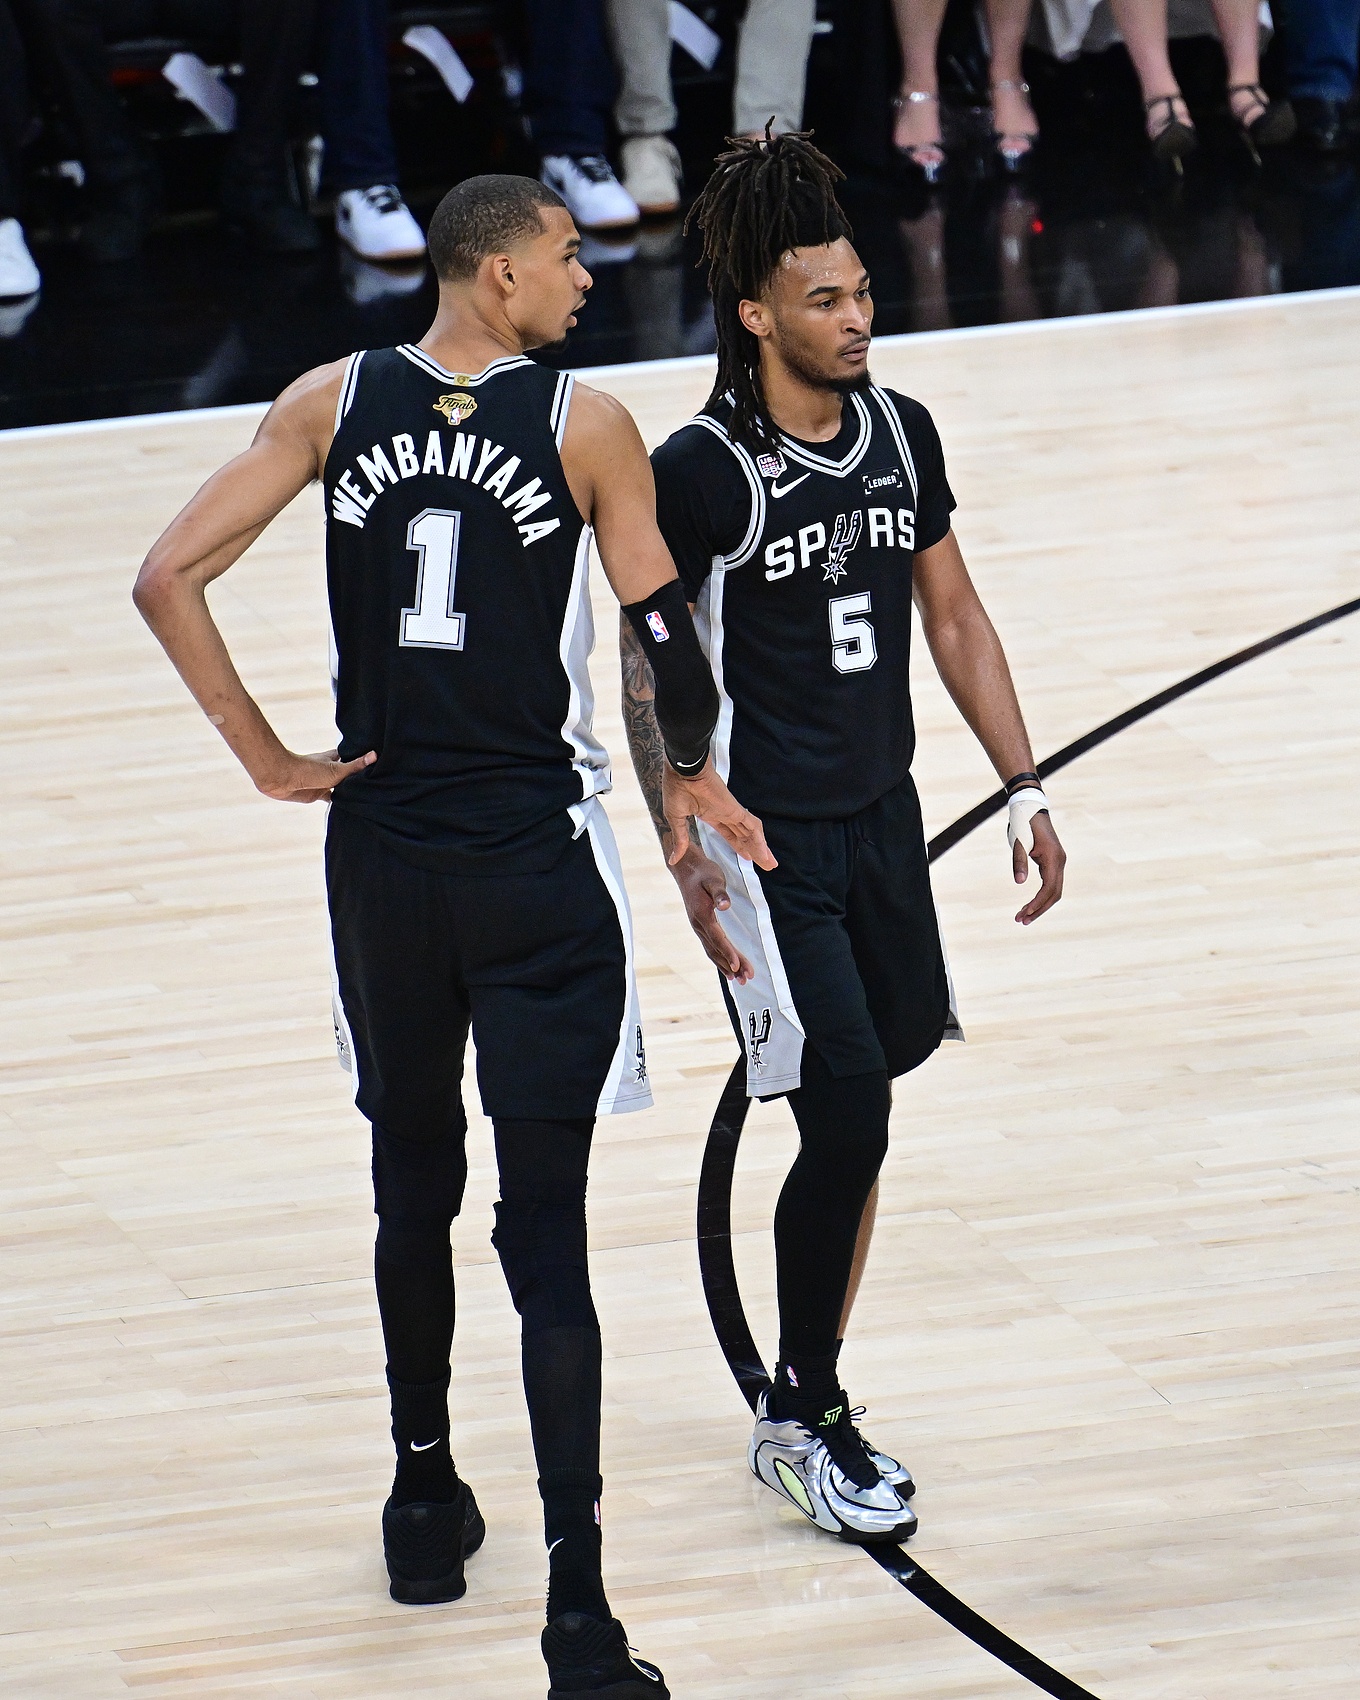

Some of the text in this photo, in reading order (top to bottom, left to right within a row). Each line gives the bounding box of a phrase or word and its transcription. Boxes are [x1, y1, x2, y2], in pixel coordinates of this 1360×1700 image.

[434, 396, 475, 410] Finals
[331, 430, 561, 548] WEMBANYAMA
[867, 474, 898, 489] LEDGER
[398, 507, 467, 651] 1
[764, 507, 916, 585] SPURS
[828, 591, 878, 674] 5
